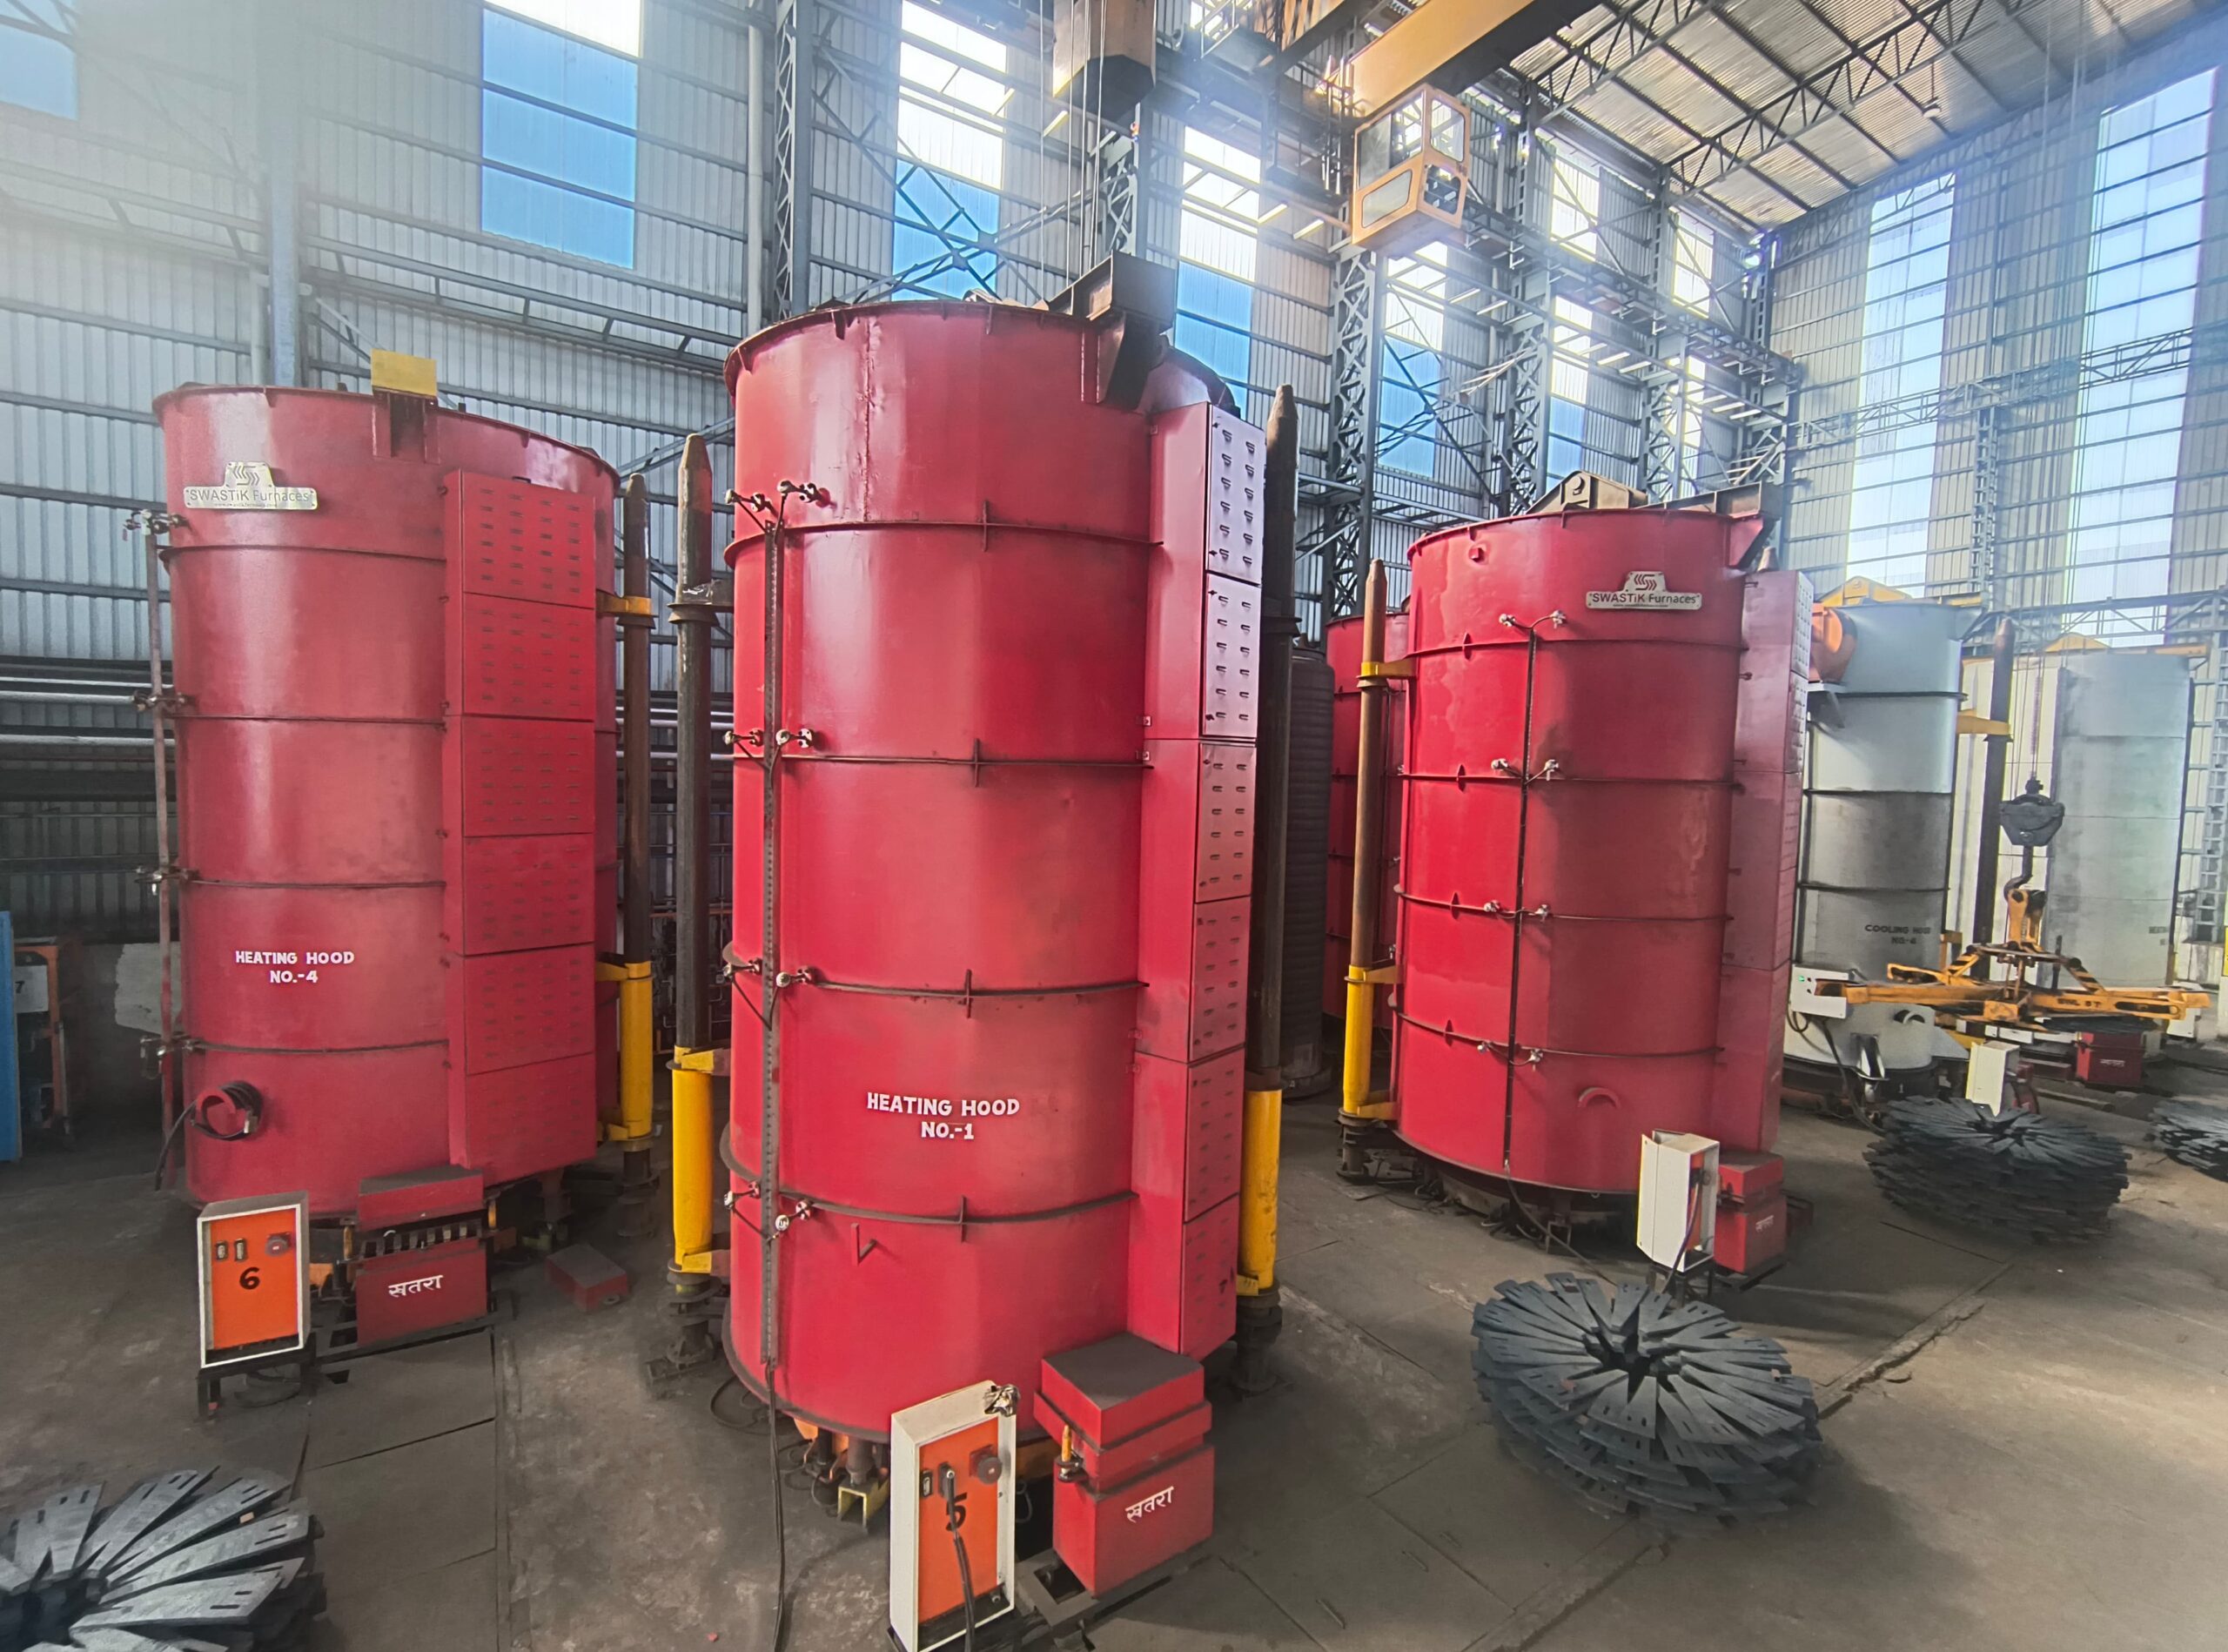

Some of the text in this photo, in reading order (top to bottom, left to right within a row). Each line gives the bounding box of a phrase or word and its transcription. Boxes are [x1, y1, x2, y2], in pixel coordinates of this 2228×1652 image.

[252, 490, 309, 502] Furnaces
[1648, 594, 1696, 604] Furnaces
[235, 950, 354, 964] HEATING HOOD
[270, 970, 319, 983] NO.-4
[867, 1092, 1020, 1117] HEATING HOOD
[921, 1122, 974, 1139] NO.-1
[239, 1267, 260, 1290] 6
